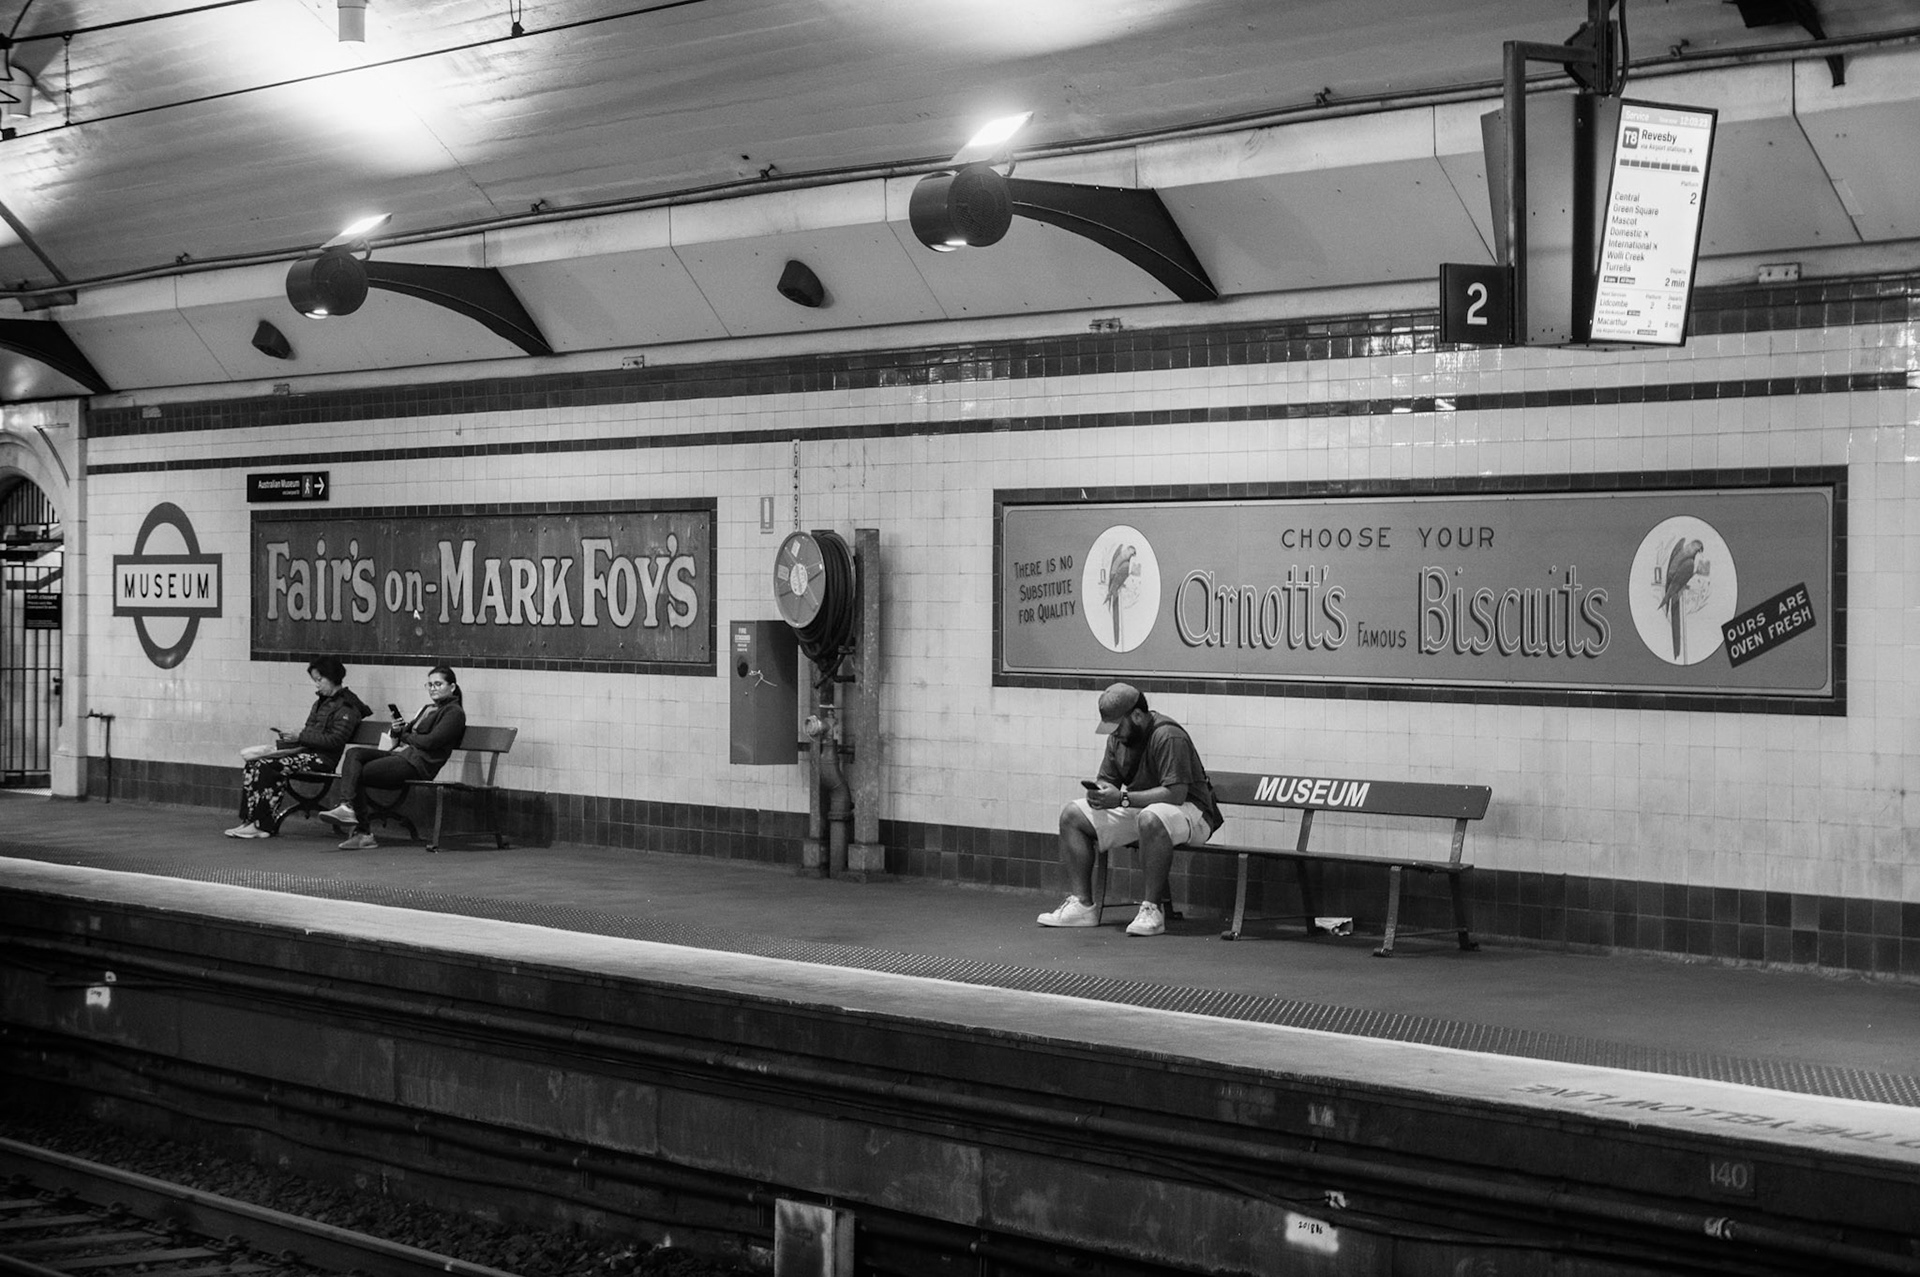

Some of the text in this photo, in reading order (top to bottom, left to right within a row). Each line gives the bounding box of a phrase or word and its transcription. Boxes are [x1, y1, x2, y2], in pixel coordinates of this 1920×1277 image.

[1625, 110, 1650, 122] Service
[1625, 130, 1638, 145] T8
[1641, 129, 1677, 145] Revesby
[1614, 191, 1640, 202] Central
[1690, 192, 1697, 205] 2
[1613, 203, 1659, 216] Green Square
[1612, 215, 1637, 226] Mascot
[1610, 227, 1642, 238] Domestic
[1608, 239, 1651, 250] International
[1607, 251, 1645, 261] Wolli Creek
[1606, 262, 1631, 272] Turrella
[1664, 277, 1685, 288] 2 min
[1467, 282, 1488, 325] 2
[1600, 299, 1628, 308] Lidcombe
[1650, 301, 1655, 310] 2
[1596, 317, 1628, 326] Macarthur
[1647, 320, 1652, 328] 2
[258, 479, 300, 489] Australian Museum
[1281, 527, 1495, 549] CHOOSE YOUR
[1014, 555, 1073, 578] THERE IS NO
[125, 573, 209, 598] MUSEUM
[266, 539, 377, 622] Fair's
[1020, 579, 1073, 601] SUBSTITUTE
[1019, 600, 1076, 624] FOR QUALITY
[1358, 621, 1407, 648] FAMOUS
[1418, 564, 1611, 659] Biscuits
[1727, 590, 1806, 641] OURS ARE
[1730, 606, 1812, 658] OVEN FRESH
[1253, 776, 1370, 807] MUSEUM
[1510, 1084, 1893, 1142] THE YELLOW LINE
[1711, 1162, 1748, 1189] 140
